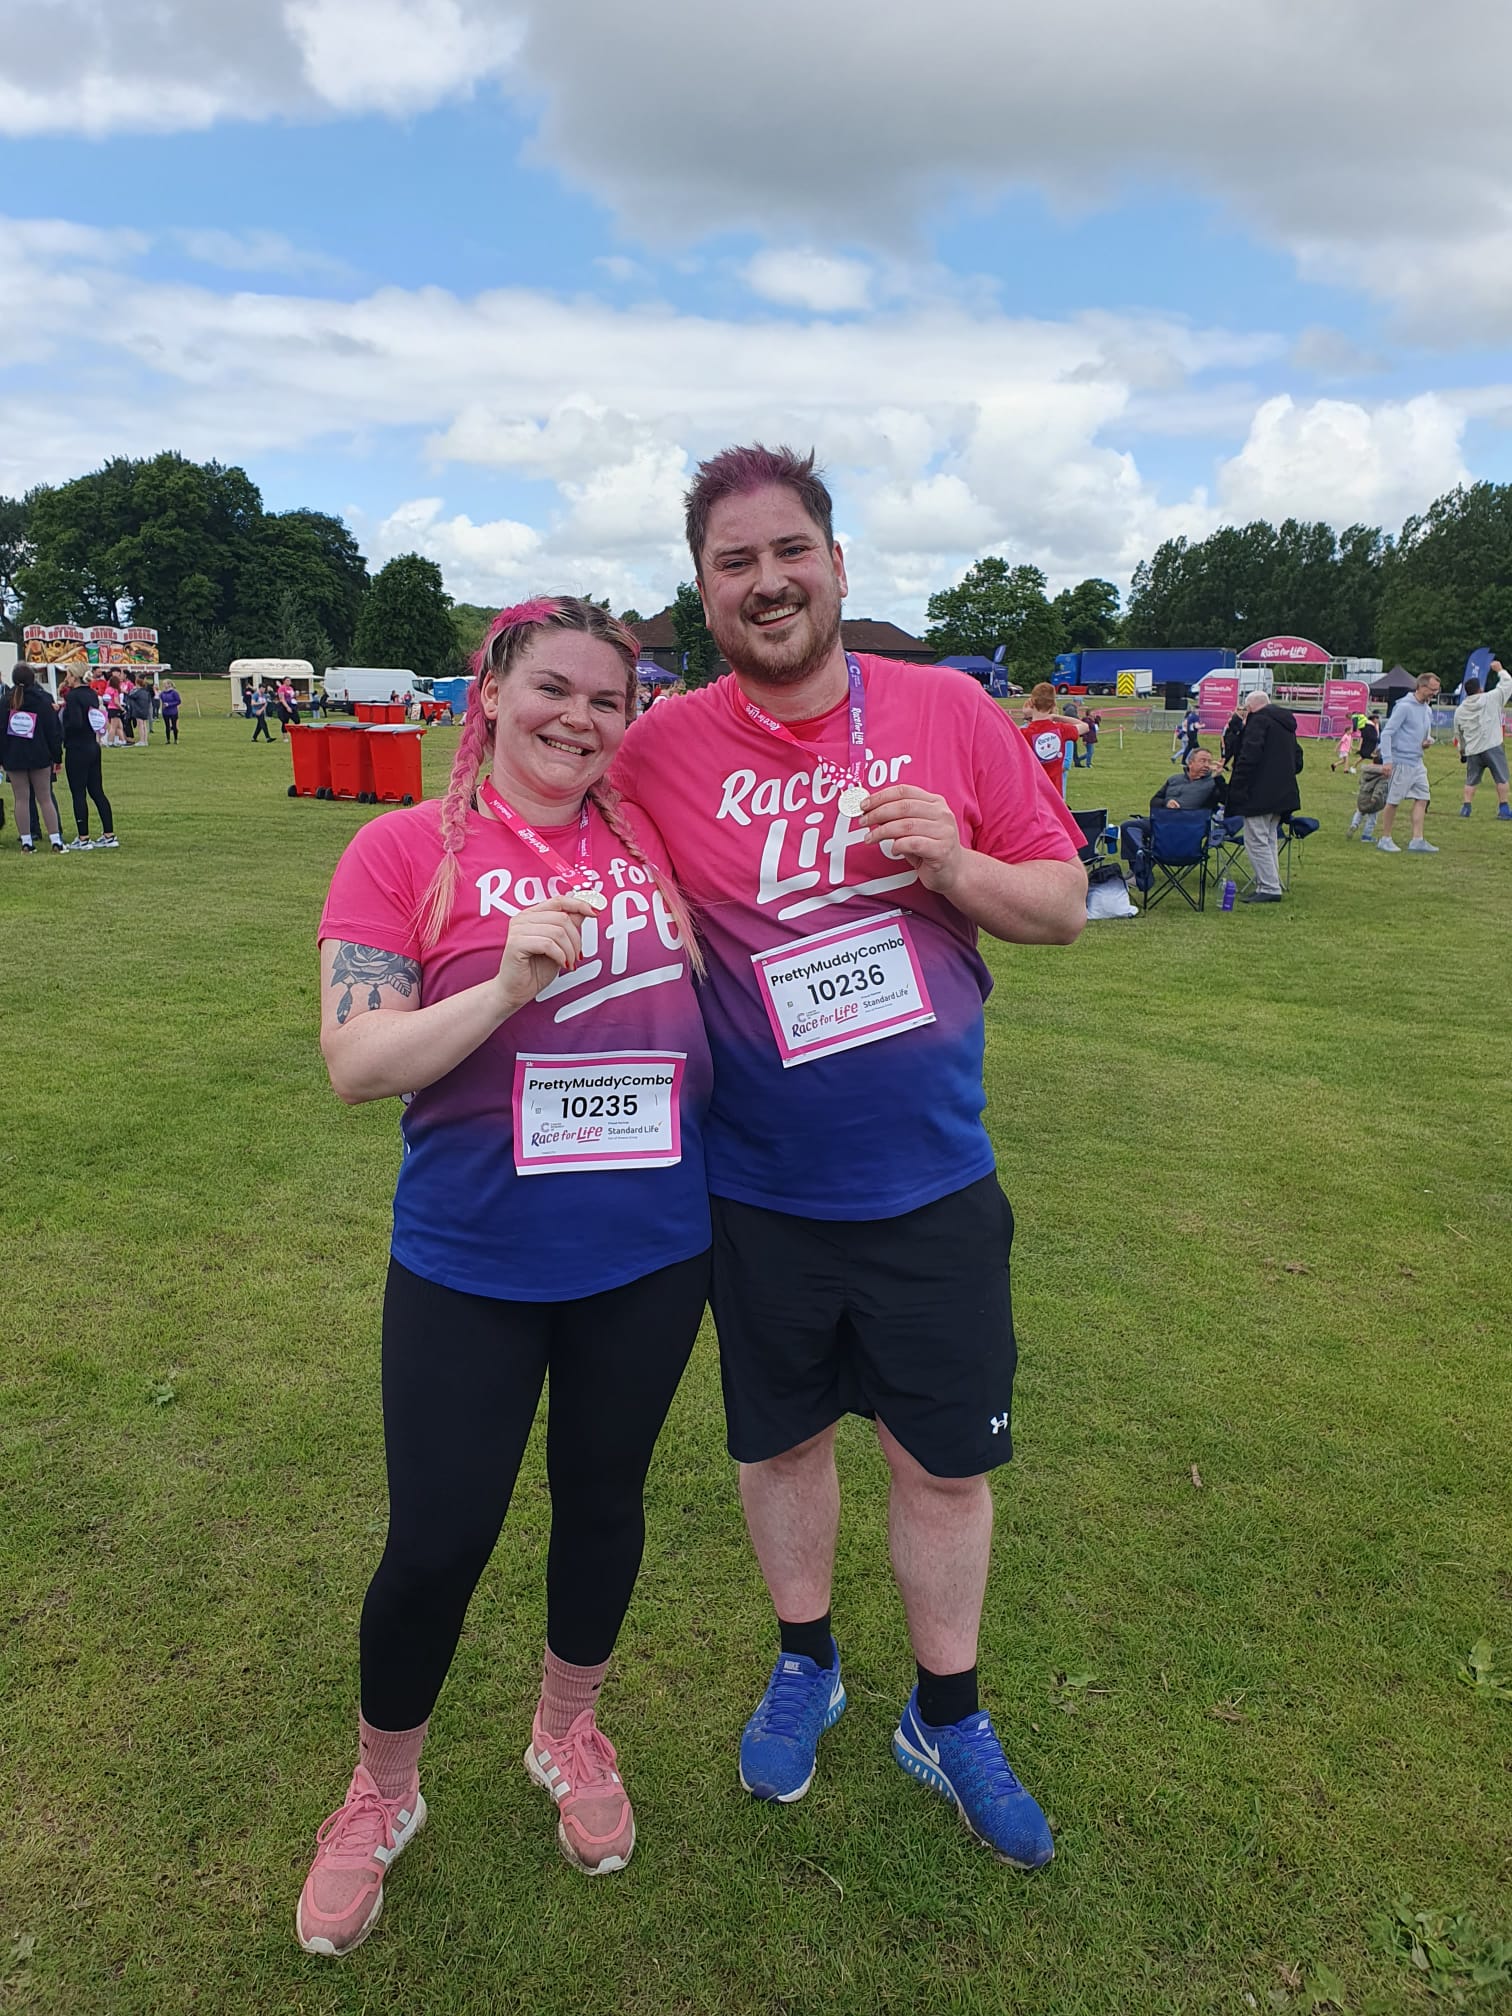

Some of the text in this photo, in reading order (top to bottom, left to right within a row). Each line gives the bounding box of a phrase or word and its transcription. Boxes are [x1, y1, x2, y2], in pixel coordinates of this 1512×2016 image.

[1260, 647, 1280, 659] Race
[851, 707, 863, 723] Race
[854, 732, 865, 745] Life
[770, 938, 905, 987] PrettyMuddyCombo
[807, 964, 885, 1005] 10236
[862, 991, 896, 1009] Standard
[895, 988, 909, 998] Life
[791, 1018, 819, 1038] Race
[819, 1014, 834, 1026] for
[834, 1002, 859, 1022] Life
[529, 1073, 674, 1092] PrettyMuddyCombo
[561, 1094, 638, 1119] 10235
[531, 1132, 560, 1147] Race
[561, 1129, 577, 1141] for
[576, 1126, 603, 1141] Life
[607, 1124, 659, 1135] Standard Life
